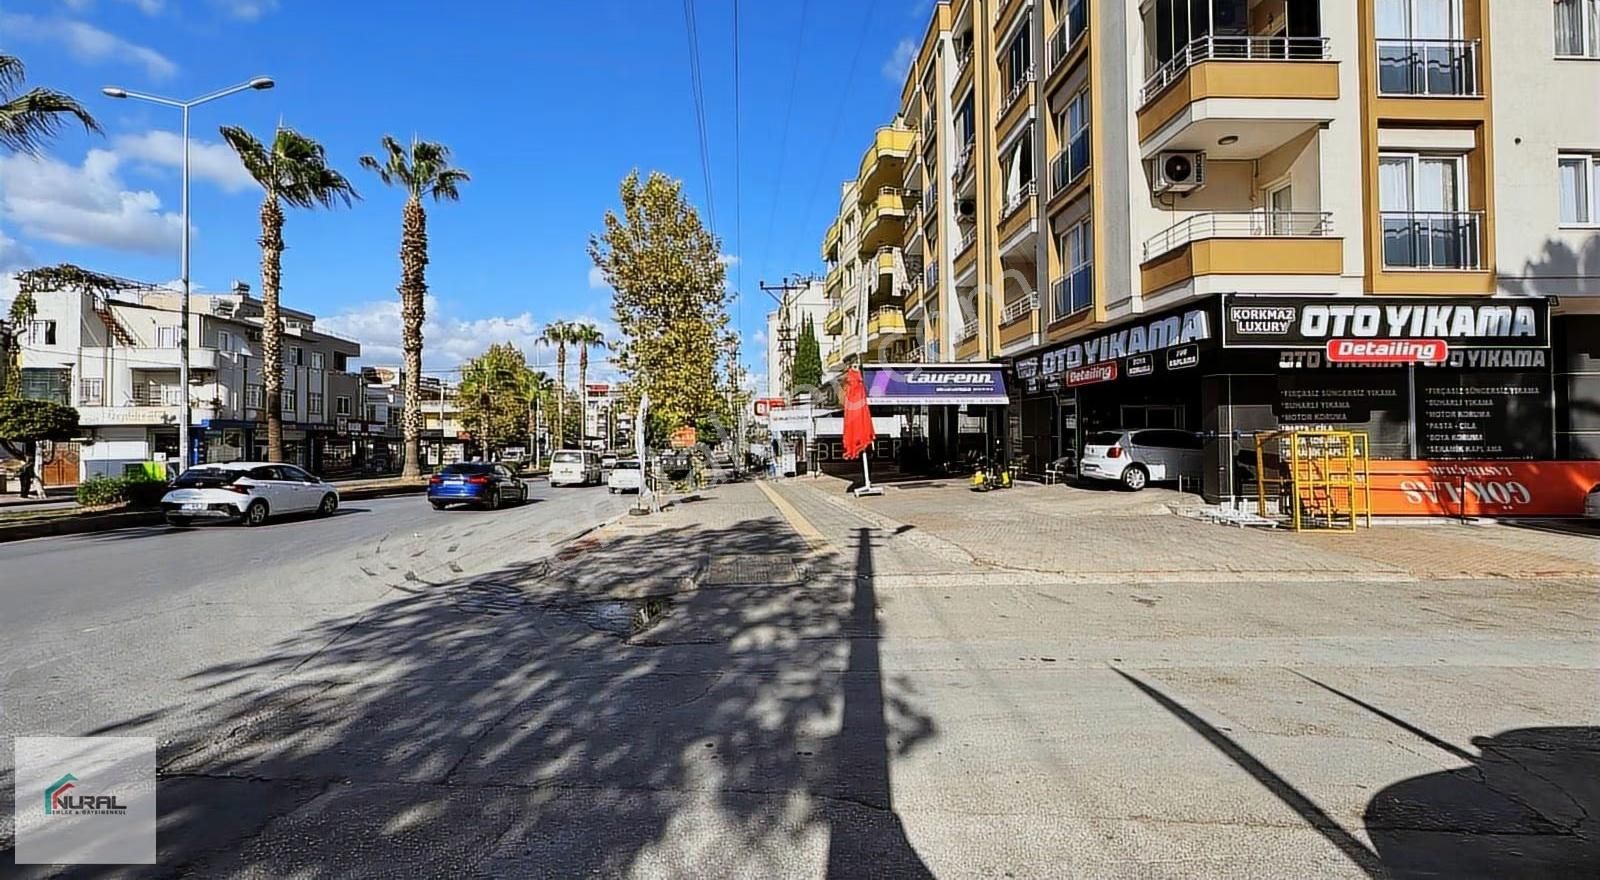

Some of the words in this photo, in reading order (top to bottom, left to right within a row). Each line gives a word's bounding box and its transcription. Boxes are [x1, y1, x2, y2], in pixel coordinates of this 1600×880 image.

[1233, 308, 1293, 320] KORKMAZ
[1300, 305, 1380, 337] OTO
[1385, 305, 1536, 337] YIKAMA
[1239, 321, 1288, 332] LUXURY
[1042, 344, 1083, 375] OTO
[1084, 309, 1211, 365] YIKAMA
[1338, 341, 1437, 359] Detailing
[1468, 350, 1546, 367] YIKAMA
[903, 373, 995, 384] Laufenn
[1070, 365, 1112, 383] Detailing
[817, 439, 902, 461] BEER
